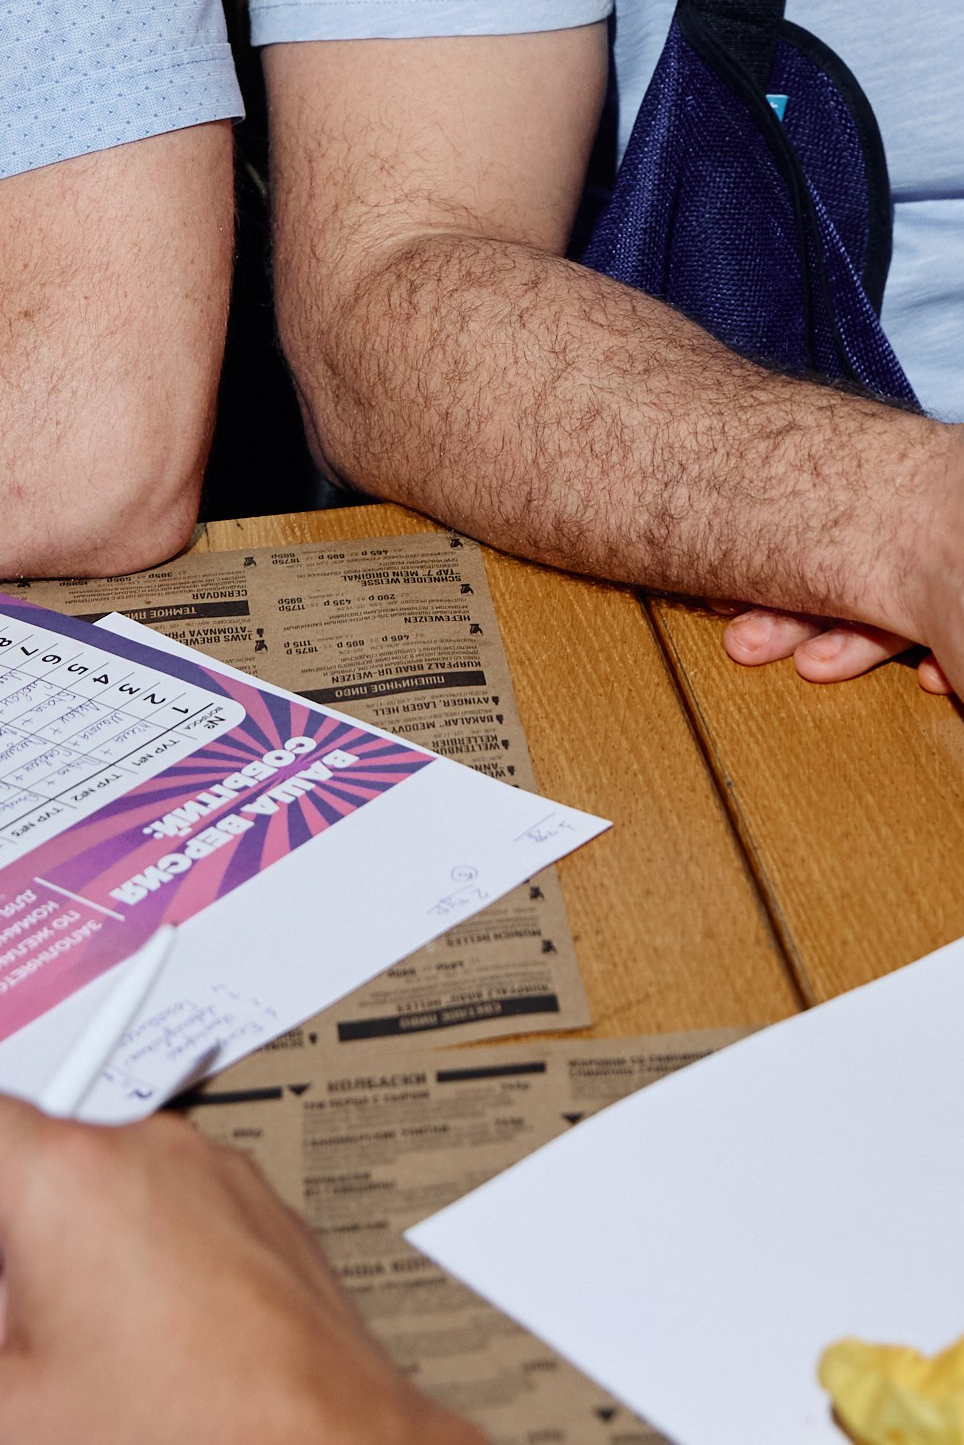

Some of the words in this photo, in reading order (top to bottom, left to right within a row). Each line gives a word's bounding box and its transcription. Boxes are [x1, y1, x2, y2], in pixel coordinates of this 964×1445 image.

[340, 572, 389, 582] ORIGINAL
[391, 570, 419, 579] MEIN
[403, 575, 462, 584] SCHNEIDER
[192, 589, 248, 600] CERNOVAR
[150, 607, 197, 618] ТЕМНОЕ
[404, 615, 470, 623] HEFEWEIZEN
[224, 634, 252, 642] JAWS
[21, 646, 39, 656] 7
[294, 646, 318, 654] 1875
[42, 654, 62, 665] 6
[68, 663, 89, 675] 5
[396, 664, 424, 674] BRAU
[426, 660, 481, 672] KURPFALZ
[92, 674, 109, 685] 4
[331, 666, 392, 684] UR-WEIZEN
[371, 675, 445, 691] ПШЕНИЧНОЕ
[119, 683, 140, 695] 3
[335, 684, 367, 698] ПИВО
[143, 694, 166, 705] 2
[172, 706, 189, 715] 1
[373, 706, 399, 716] HELL
[402, 701, 436, 712] LAGER
[183, 706, 223, 731] ВОПРОСА
[391, 721, 435, 732] MEDOVY
[154, 738, 179, 755] ТУР
[431, 735, 498, 747] KELLERBIER
[97, 774, 122, 789] ТУР
[240, 749, 359, 816] ВАША
[142, 736, 316, 839] СОБЫТИЙ:
[37, 808, 63, 824] ТУР
[109, 814, 254, 905] ВЕРСИЯ
[52, 910, 81, 930] ПО
